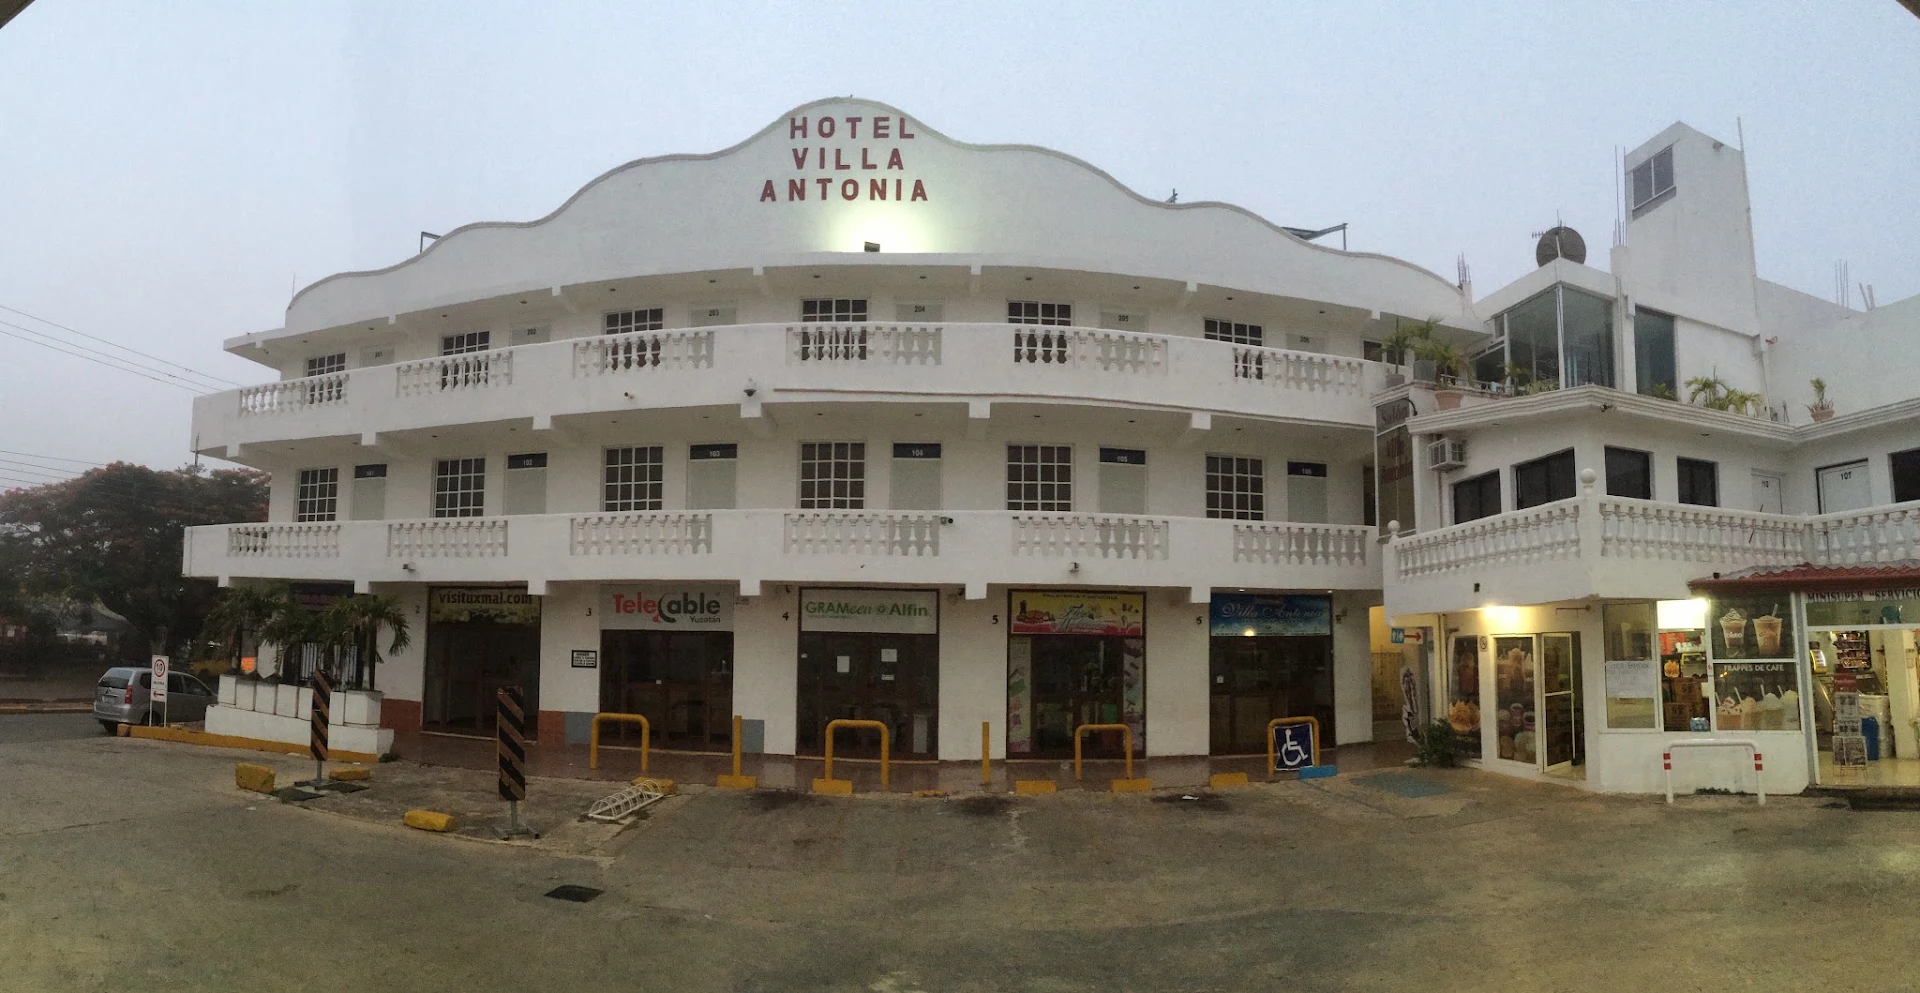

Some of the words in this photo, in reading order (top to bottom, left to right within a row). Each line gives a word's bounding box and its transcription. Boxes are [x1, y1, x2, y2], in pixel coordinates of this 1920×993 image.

[789, 116, 915, 139] HOTEL
[792, 147, 904, 170] VILLA
[760, 178, 928, 202] ANTONIA
[708, 309, 720, 317] 203
[914, 305, 925, 313] 204
[1118, 314, 1129, 322] 205
[527, 328, 537, 336] 202
[709, 450, 721, 458] 103
[912, 449, 924, 457] 104
[523, 459, 533, 467] 102
[438, 591, 533, 604] visituxmal.com
[1806, 590, 1864, 602] MINISUPER
[585, 607, 592, 617] 3
[611, 591, 721, 623] TeleCable
[805, 601, 872, 615] GRAMeen
[888, 603, 928, 617] Alfin
[1220, 602, 1258, 618] Villa
[1262, 605, 1322, 619] Antonia
[689, 614, 721, 623] Yucatán
[782, 611, 789, 621] 4
[992, 614, 999, 625] 5
[1723, 664, 1753, 672] FRAPPES
